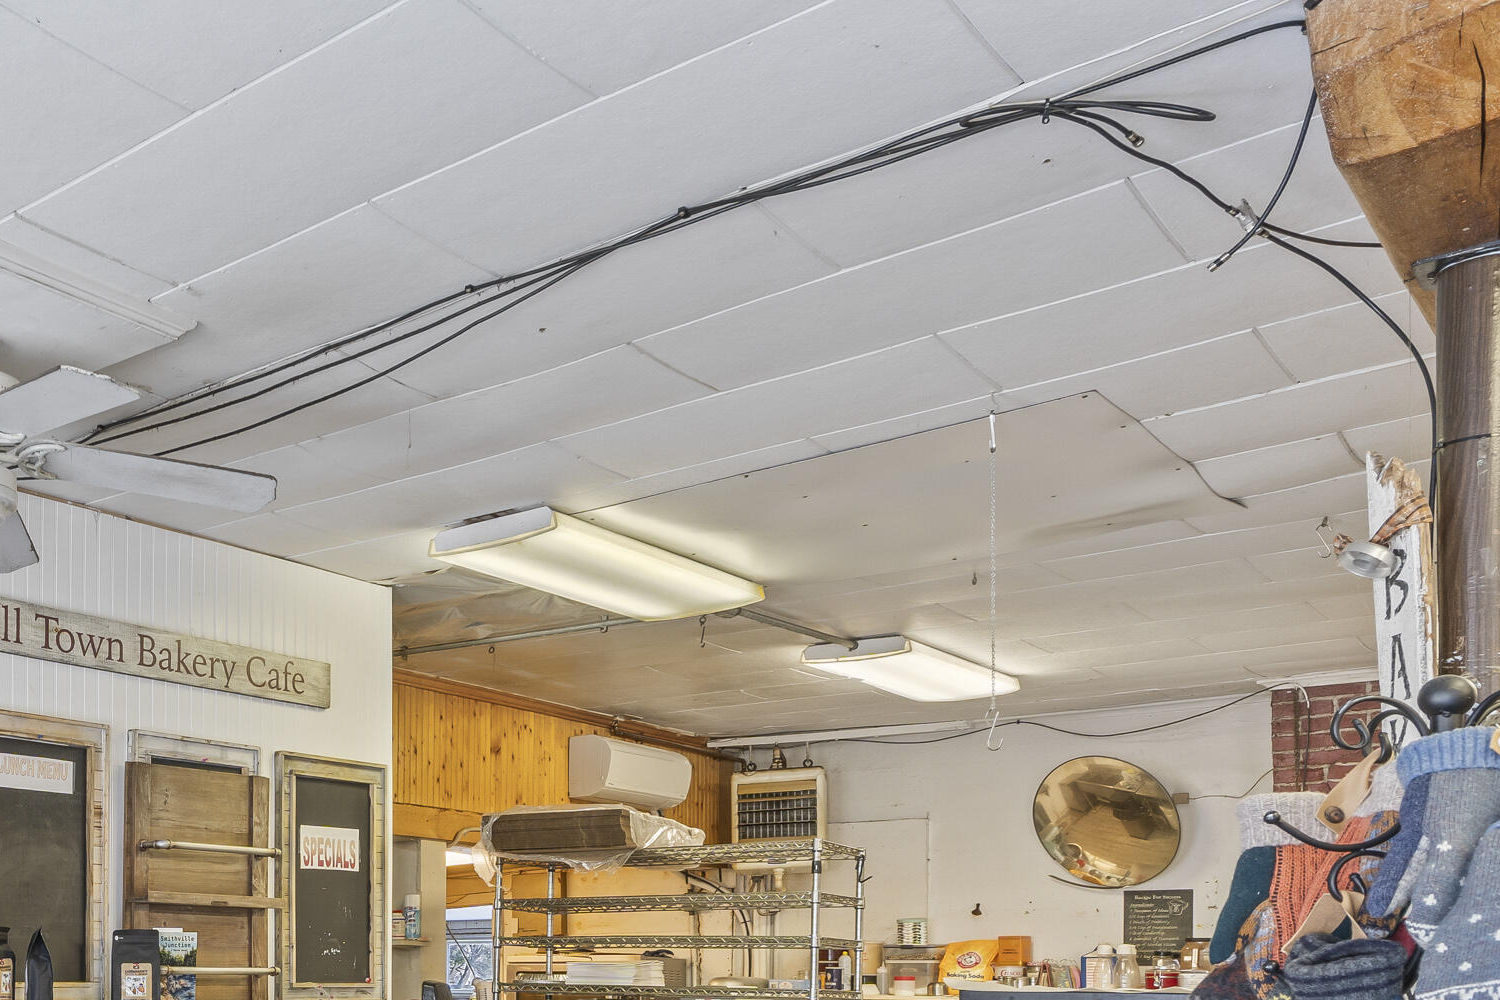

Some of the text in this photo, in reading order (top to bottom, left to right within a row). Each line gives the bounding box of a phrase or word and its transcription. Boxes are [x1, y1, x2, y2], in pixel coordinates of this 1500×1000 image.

[35, 614, 125, 663] Town
[137, 634, 237, 687] Bakery
[246, 656, 306, 694] Cafe
[37, 761, 69, 781] MENU
[303, 836, 356, 869] SPECIALS
